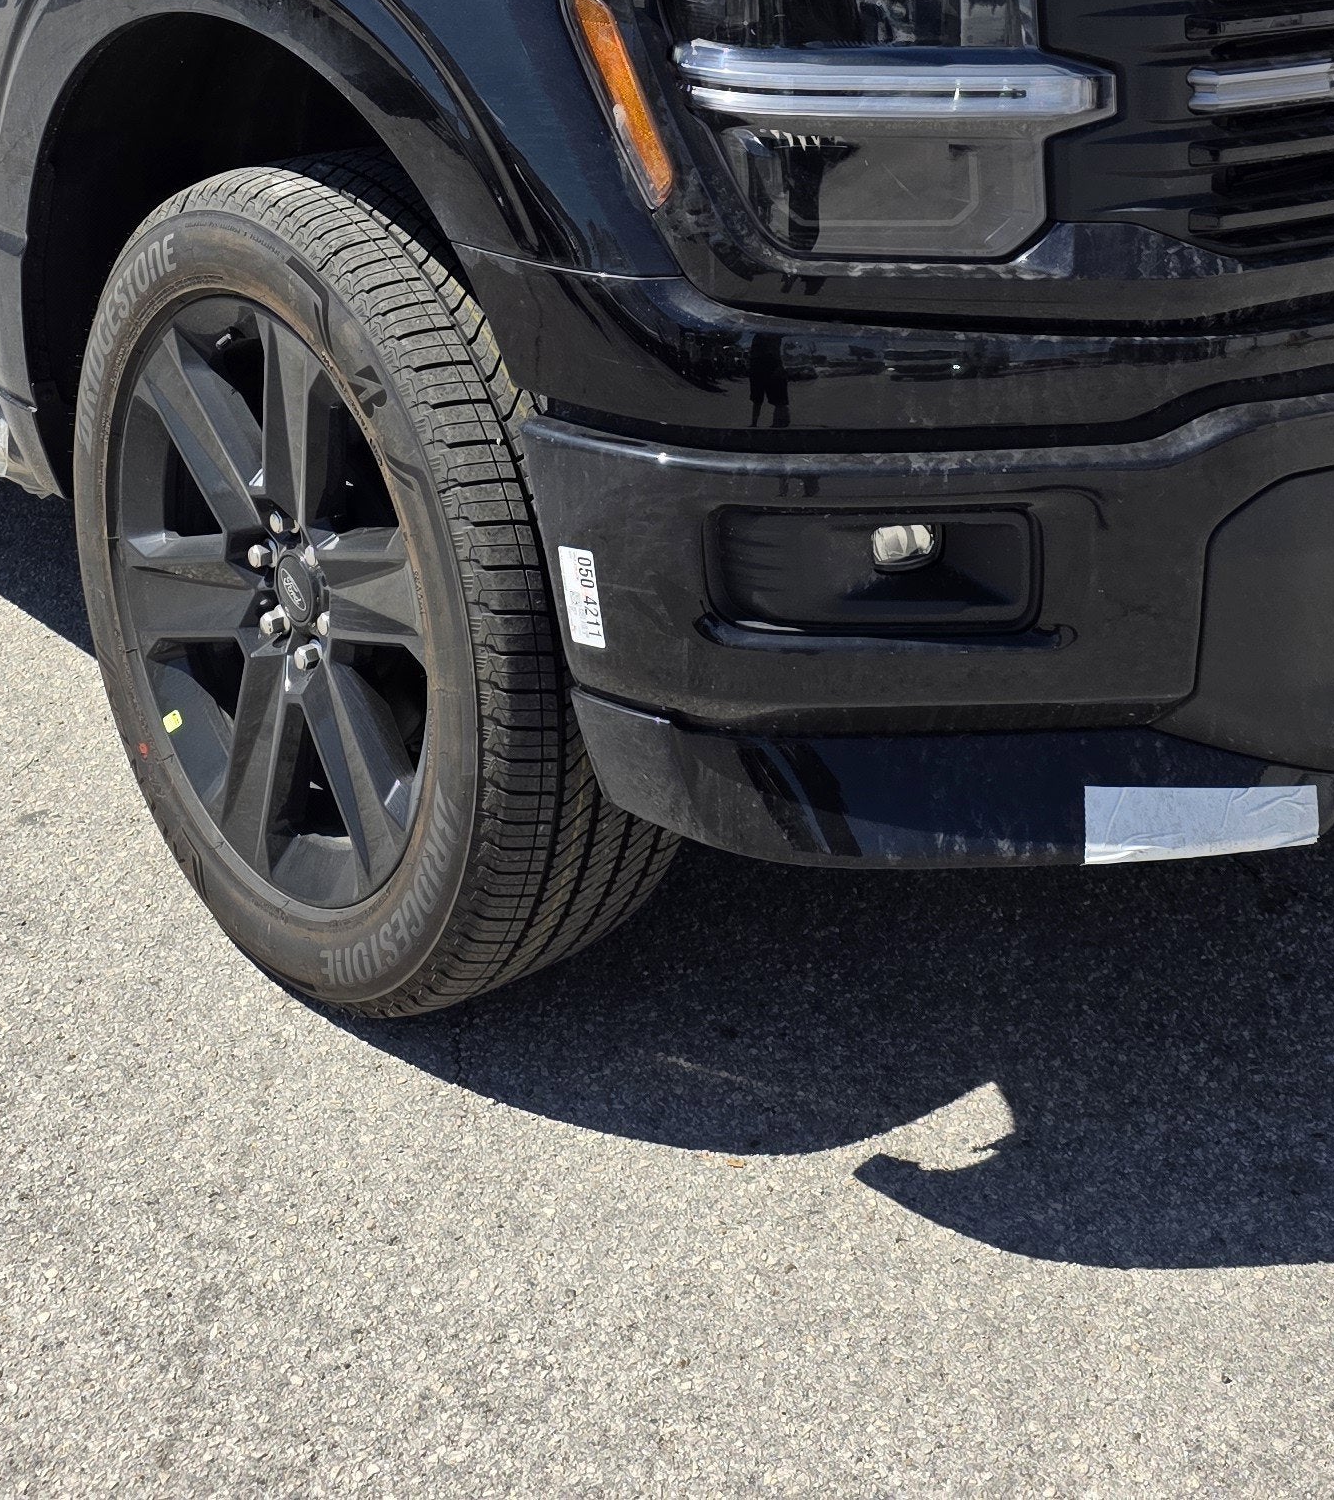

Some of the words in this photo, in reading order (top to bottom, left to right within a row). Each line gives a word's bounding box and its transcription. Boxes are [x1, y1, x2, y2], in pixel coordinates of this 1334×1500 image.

[76, 232, 178, 456] BRIDGESTONE
[577, 556, 595, 589] 050
[583, 595, 603, 638] 4211
[319, 779, 463, 987] BRIDGESTONE
